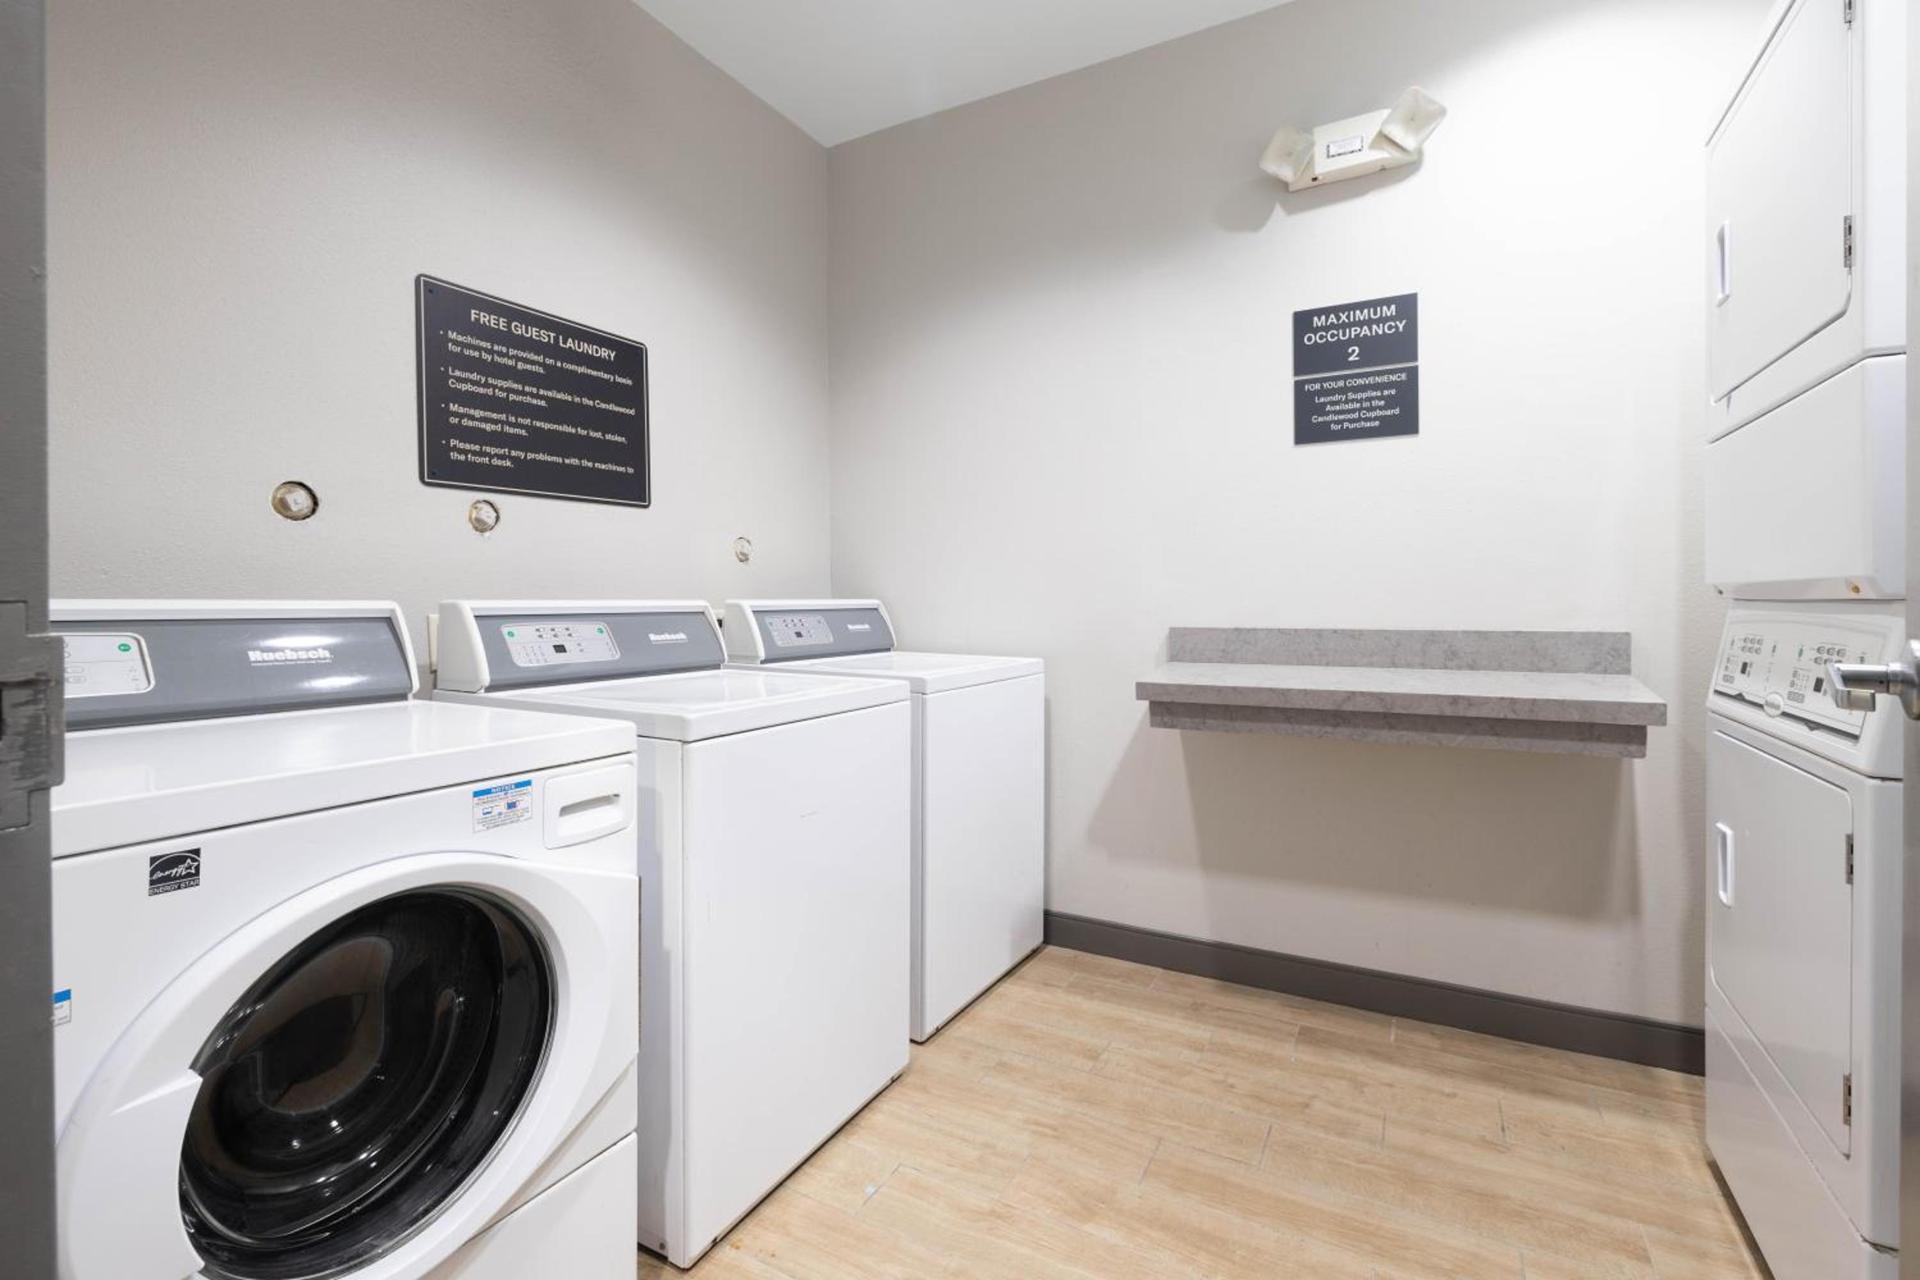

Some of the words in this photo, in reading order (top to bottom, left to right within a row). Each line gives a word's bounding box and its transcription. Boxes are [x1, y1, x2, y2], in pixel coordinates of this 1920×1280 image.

[1312, 304, 1396, 328] MAXIMUM
[471, 308, 508, 331] FREE
[511, 321, 556, 344] GUEST
[559, 335, 616, 362] LAUNDRY
[1304, 319, 1407, 345] OCCUPANCY
[448, 330, 492, 349] Machines
[493, 343, 507, 353] are
[509, 348, 543, 362] provided
[545, 357, 555, 366] on
[563, 362, 614, 382] complimentary
[615, 374, 633, 386] basis
[448, 342, 461, 353] for
[463, 347, 480, 358] use
[482, 350, 493, 362] by
[494, 354, 515, 367] hotel
[517, 361, 545, 374] guests.
[1347, 346, 1360, 361] 2
[448, 366, 486, 384] Laundry
[487, 377, 523, 391] supplies
[524, 384, 537, 394] are
[538, 387, 572, 401] available
[574, 394, 581, 403] in
[582, 397, 594, 407] the
[594, 400, 635, 416] Candlewood
[448, 379, 493, 395] Cupboard
[494, 389, 507, 398] for
[509, 393, 548, 408] purchase.
[1305, 383, 1321, 392] FOR
[1322, 379, 1344, 390] YOUR
[1346, 372, 1407, 387] CONVENIENCE
[1315, 392, 1346, 404] Laundry
[1347, 390, 1381, 401] Supplies
[1325, 402, 1361, 412] Available
[1363, 400, 1370, 408] in
[1371, 399, 1385, 407] the
[449, 403, 506, 421] Management
[508, 413, 516, 423] is
[517, 417, 531, 426] not
[533, 420, 576, 434] responsible
[577, 427, 588, 436] for
[589, 430, 604, 439] lost,
[605, 433, 628, 444] stolen,
[449, 416, 459, 424] or
[461, 418, 501, 432] damaged
[503, 426, 528, 436] items.
[1311, 409, 1359, 423] Candlewood
[1360, 407, 1400, 419] Cupboard
[1330, 423, 1341, 431] for
[1343, 419, 1380, 429] Purchase
[450, 438, 481, 451] Please
[482, 445, 509, 455] report
[510, 450, 526, 459] any
[527, 452, 562, 464] problems
[564, 457, 580, 466] with
[581, 459, 593, 468] the
[594, 462, 626, 473] machines
[450, 451, 466, 461] the
[468, 453, 490, 465] front
[491, 458, 514, 468] desk.
